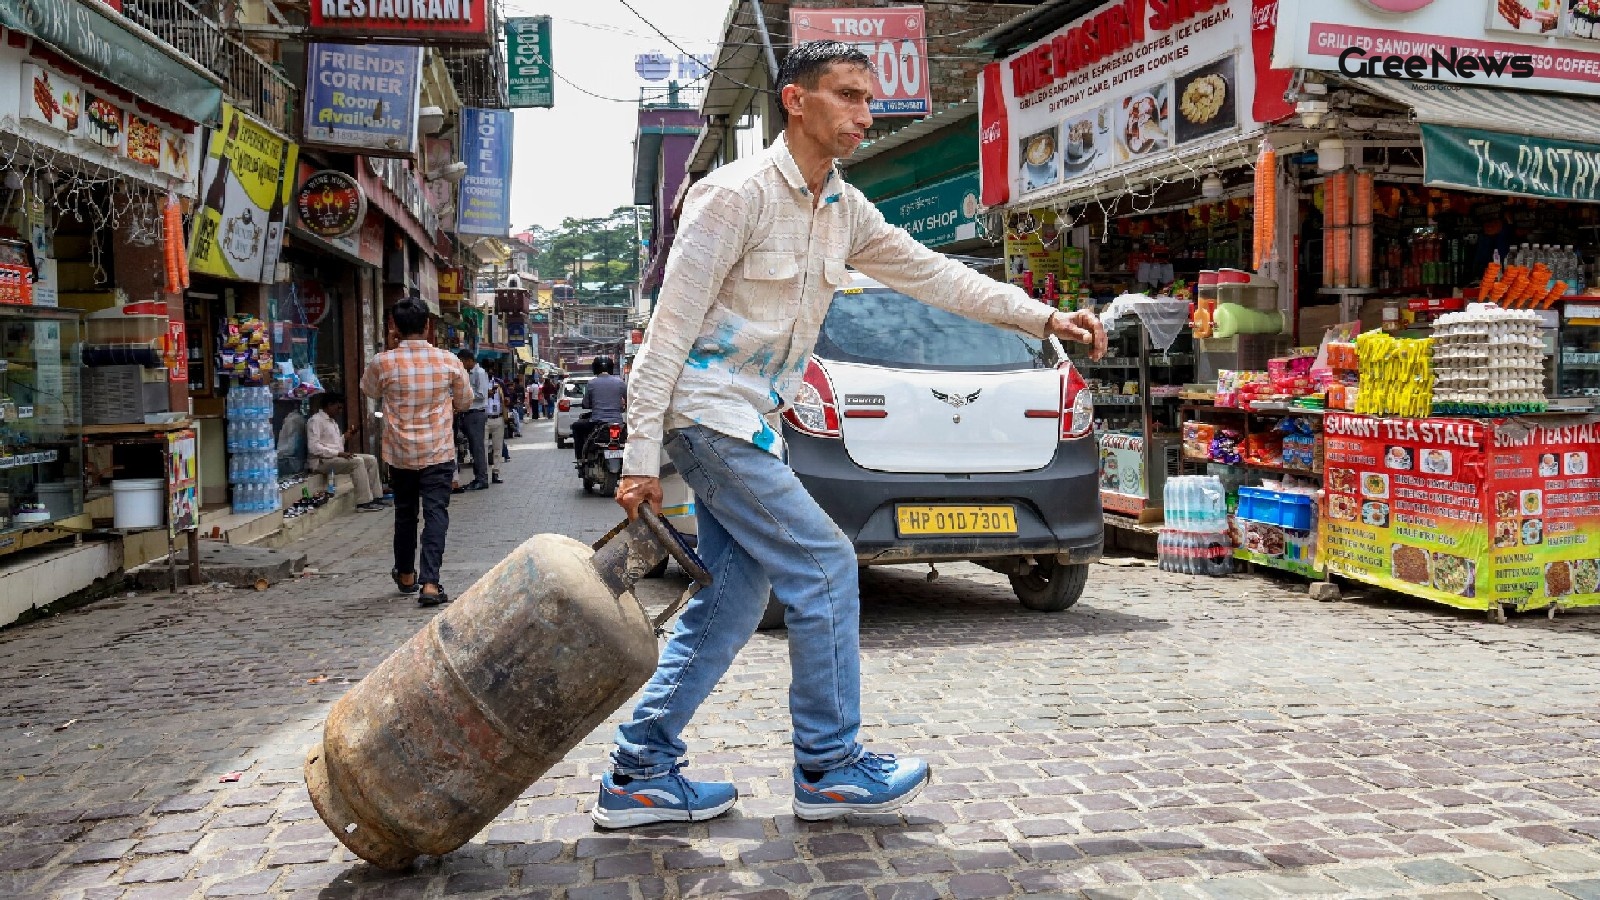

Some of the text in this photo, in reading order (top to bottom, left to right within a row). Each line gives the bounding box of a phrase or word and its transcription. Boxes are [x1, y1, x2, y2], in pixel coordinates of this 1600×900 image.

[321, 0, 473, 20] RESTAURANT
[77, 8, 111, 65] Shop
[832, 19, 885, 35] TROY
[1175, 25, 1192, 43] ICE
[514, 23, 543, 75] ROOMS
[1317, 32, 1373, 51] GRILLED
[320, 51, 404, 75] FRIENDS
[1010, 44, 1054, 97] THE
[1112, 63, 1145, 88] BUTTER
[1147, 45, 1189, 71] COOKIES
[320, 70, 403, 96] CORNER
[332, 91, 390, 112] Rooms
[478, 112, 495, 174] HOTEL
[926, 209, 958, 230] SHOP
[1326, 415, 1480, 448] SUNNY TEA STALL
[910, 511, 931, 530] HP
[971, 511, 1011, 531] 7301
